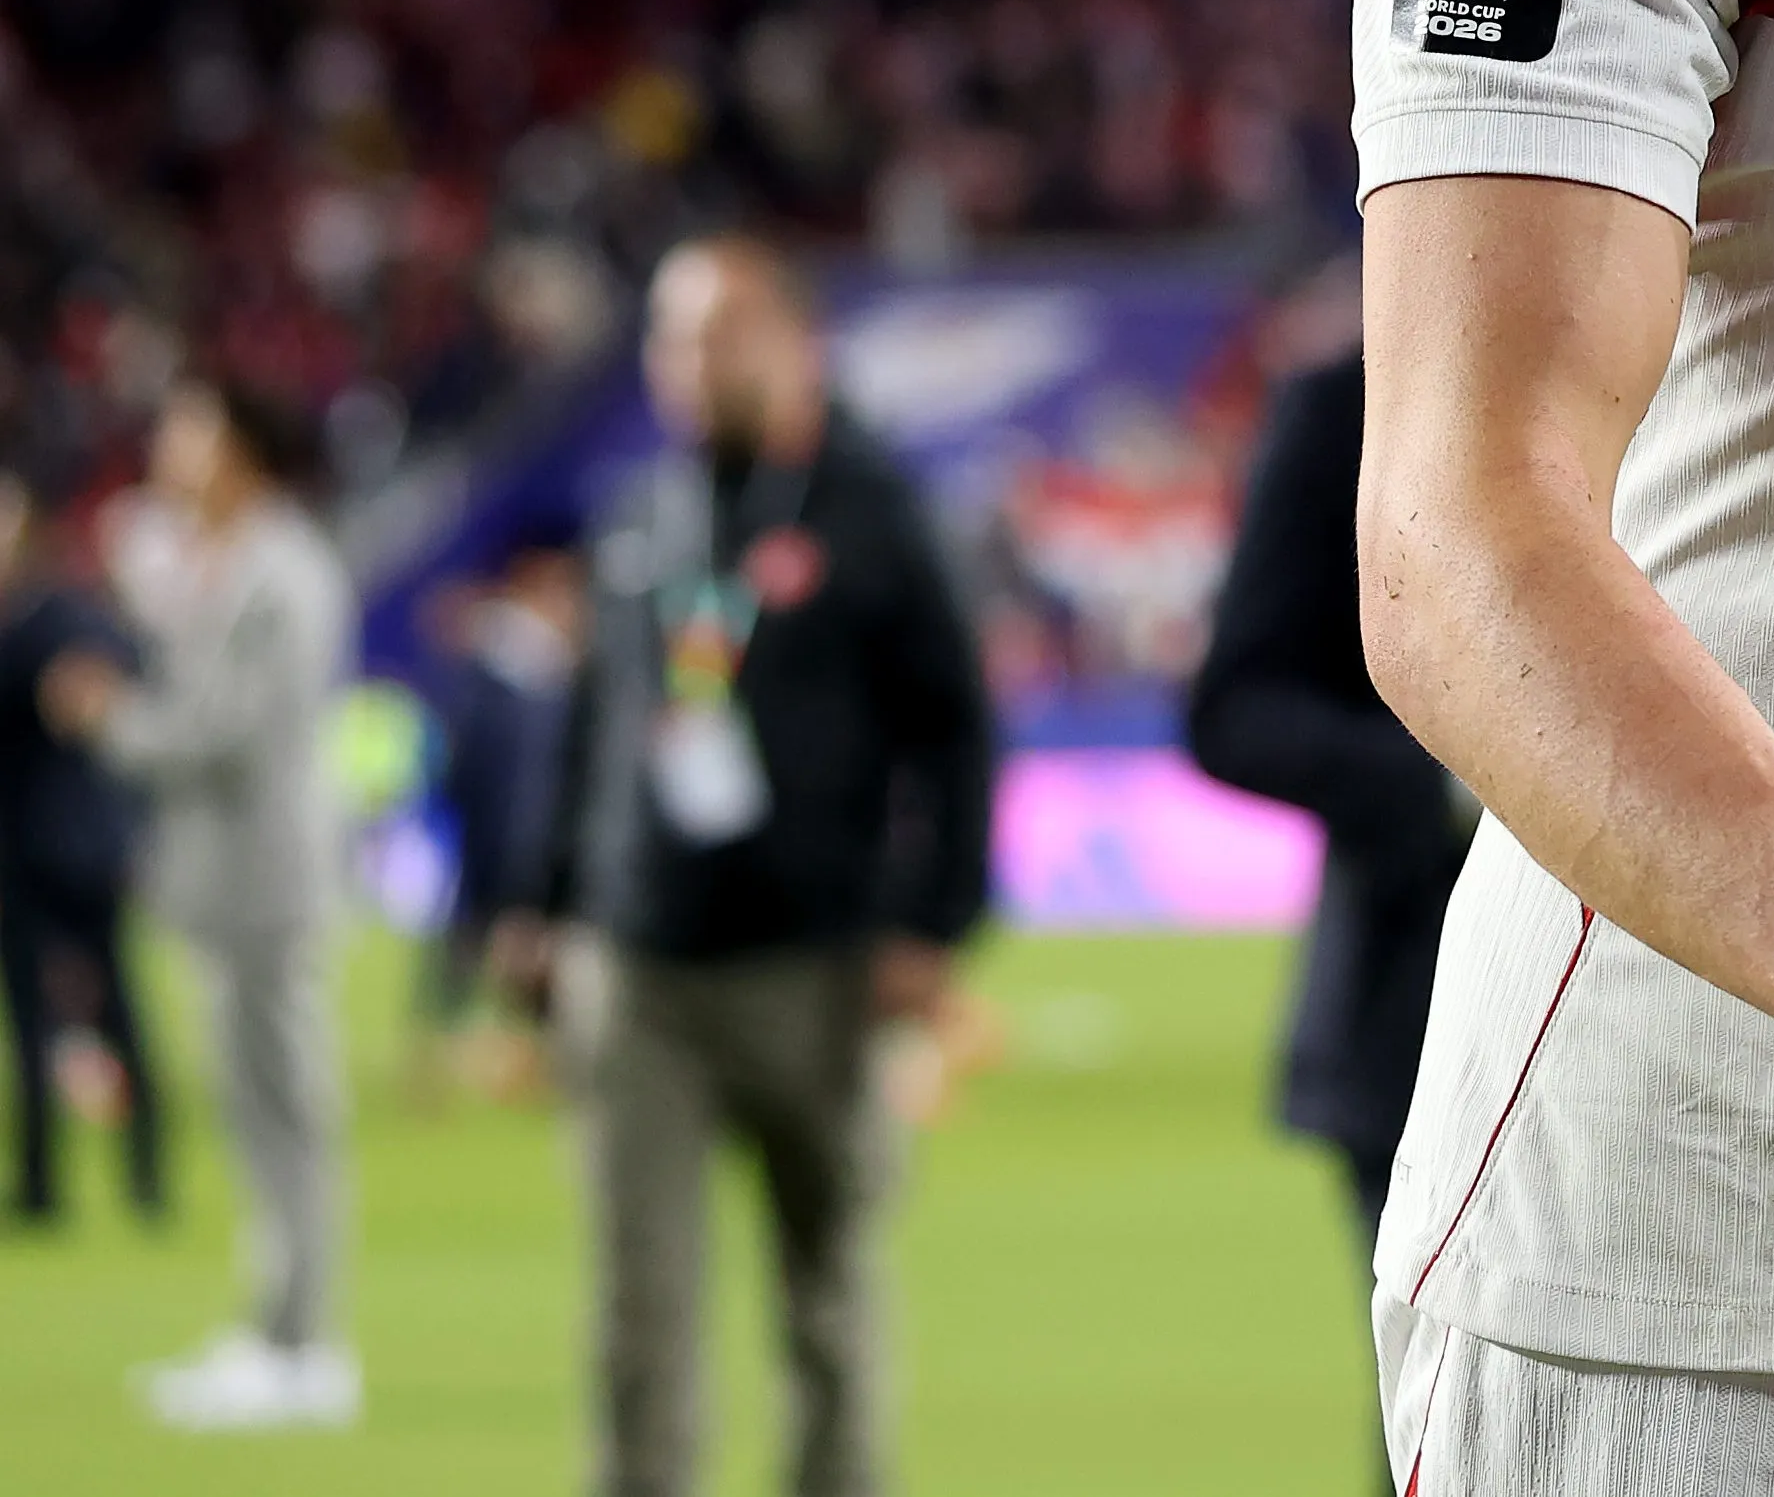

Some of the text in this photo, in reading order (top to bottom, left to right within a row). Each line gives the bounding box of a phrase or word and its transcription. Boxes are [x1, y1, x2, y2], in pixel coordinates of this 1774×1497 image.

[1418, 0, 1506, 20] ORLD CUP
[1414, 14, 1502, 42] 2026
